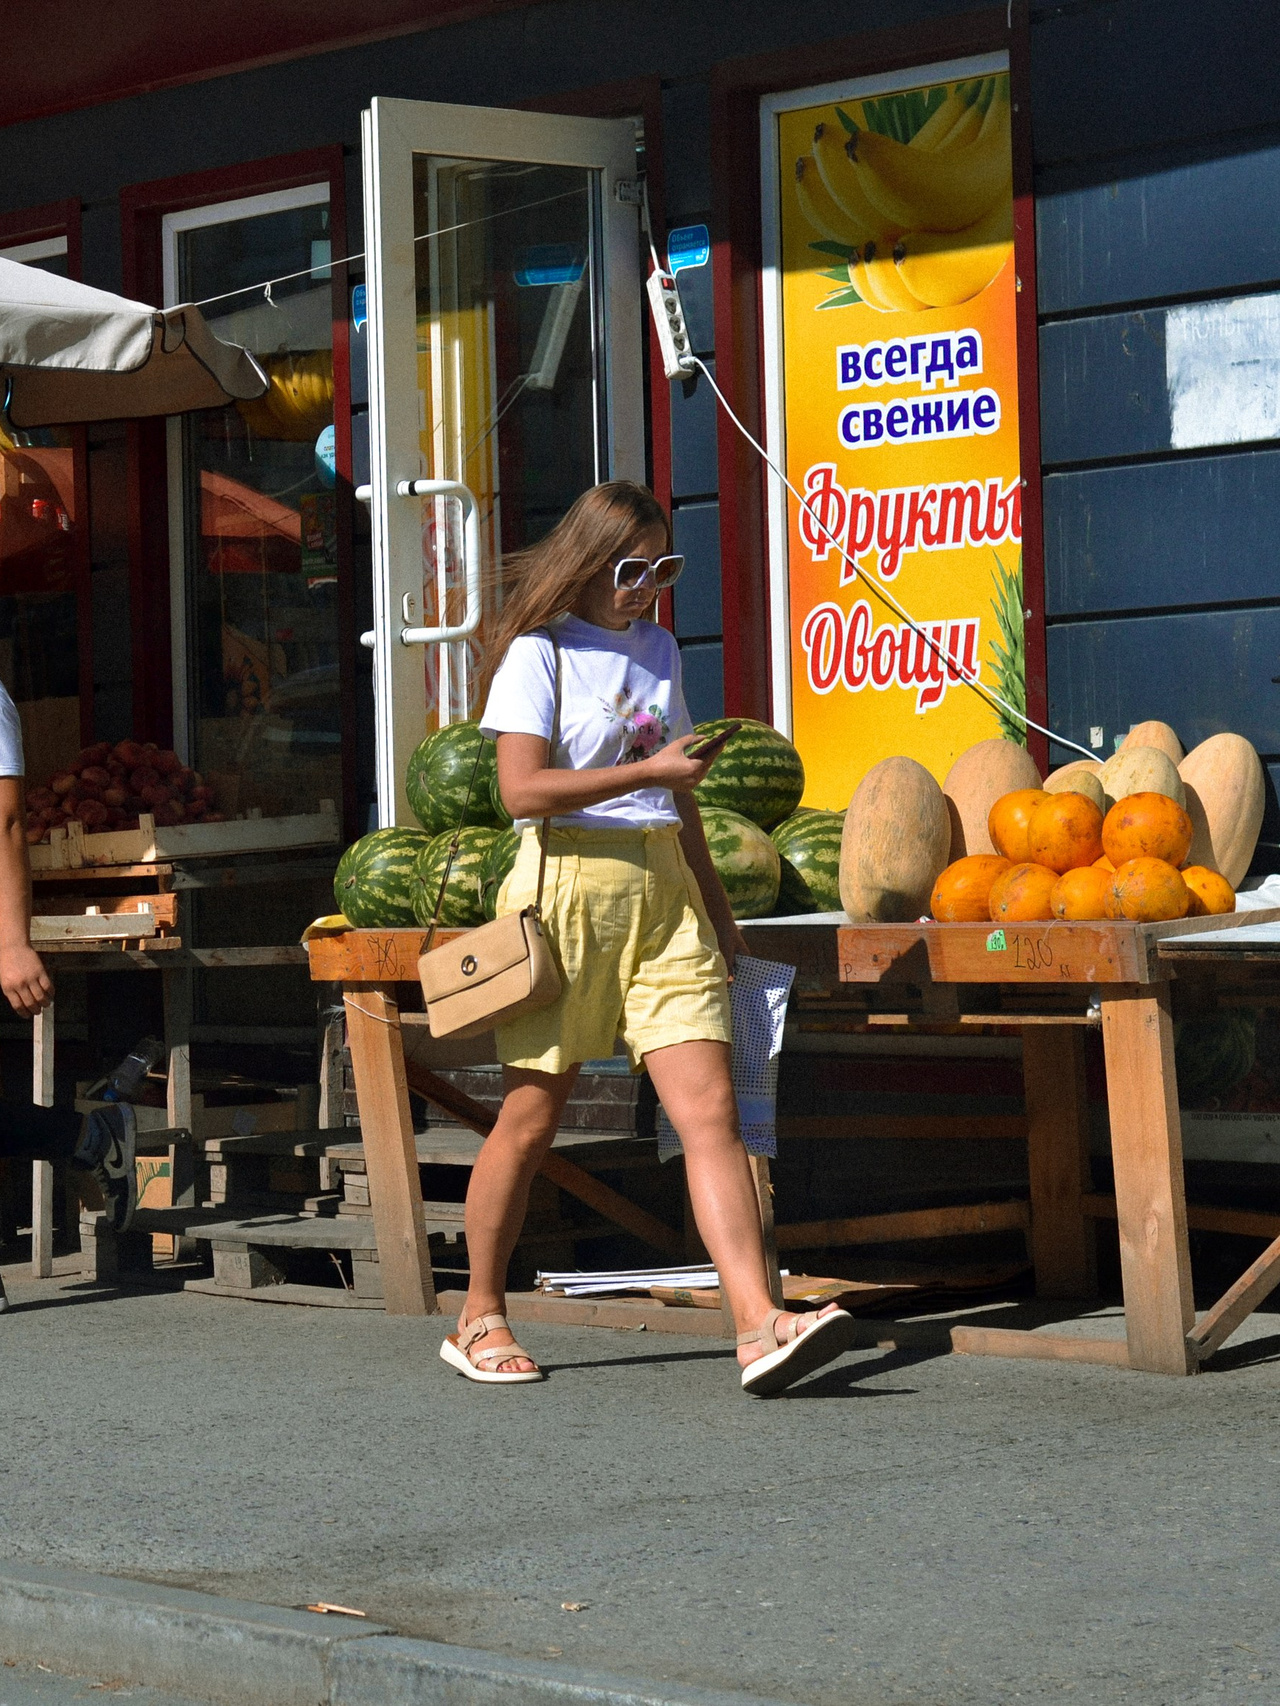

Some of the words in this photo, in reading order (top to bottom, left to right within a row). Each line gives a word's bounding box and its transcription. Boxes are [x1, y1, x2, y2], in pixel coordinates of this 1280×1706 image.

[840, 333, 979, 384] всегда
[841, 393, 997, 443] свежие
[802, 467, 1023, 579] Фрукты
[805, 604, 978, 708] Овощи
[1012, 934, 1053, 971] 120
